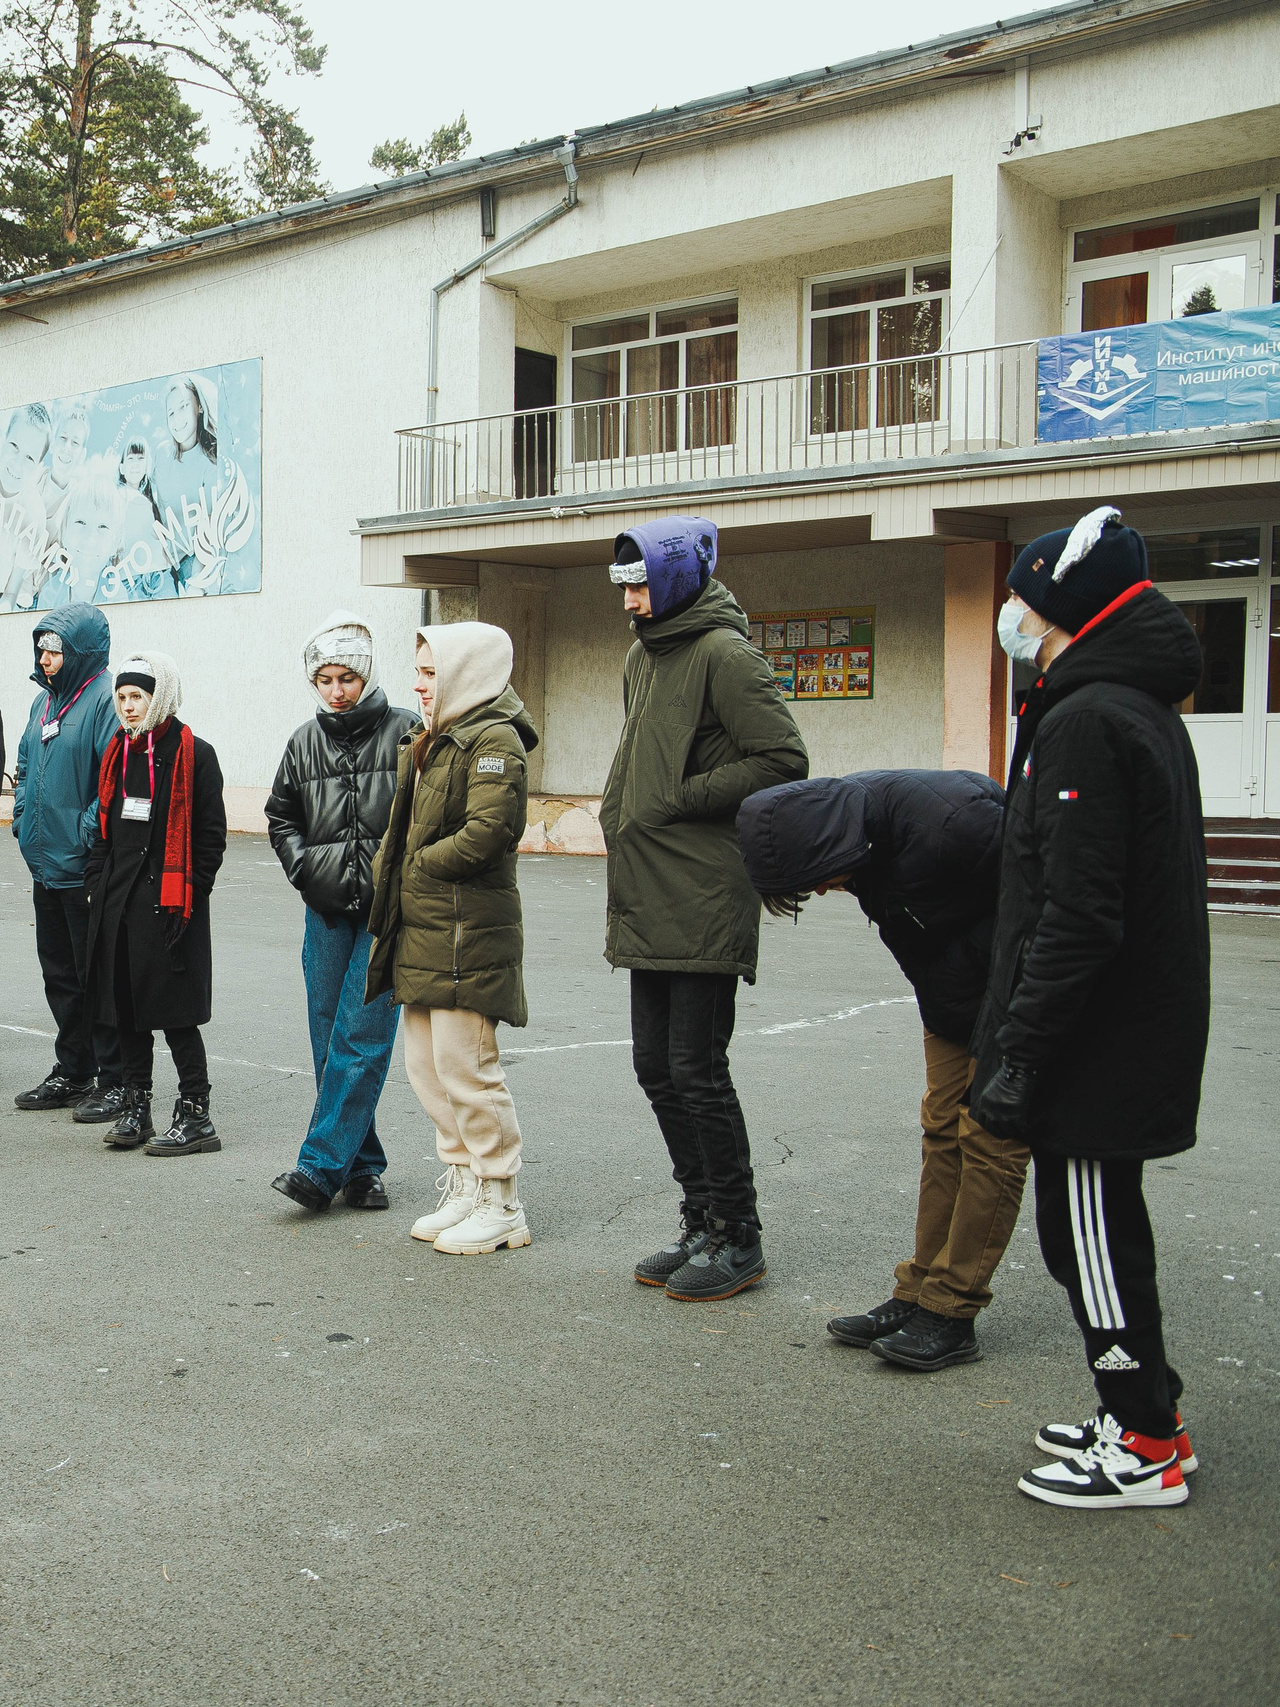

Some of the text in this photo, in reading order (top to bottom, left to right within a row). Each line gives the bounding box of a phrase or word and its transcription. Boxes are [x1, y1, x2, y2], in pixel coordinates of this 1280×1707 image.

[1157, 344, 1247, 367] Институт
[101, 540, 152, 598] ЭТО
[778, 610, 844, 619] БЕЗОПАСНОСТЬ
[478, 764, 503, 772] MODE
[1094, 1360, 1140, 1370] adidas
